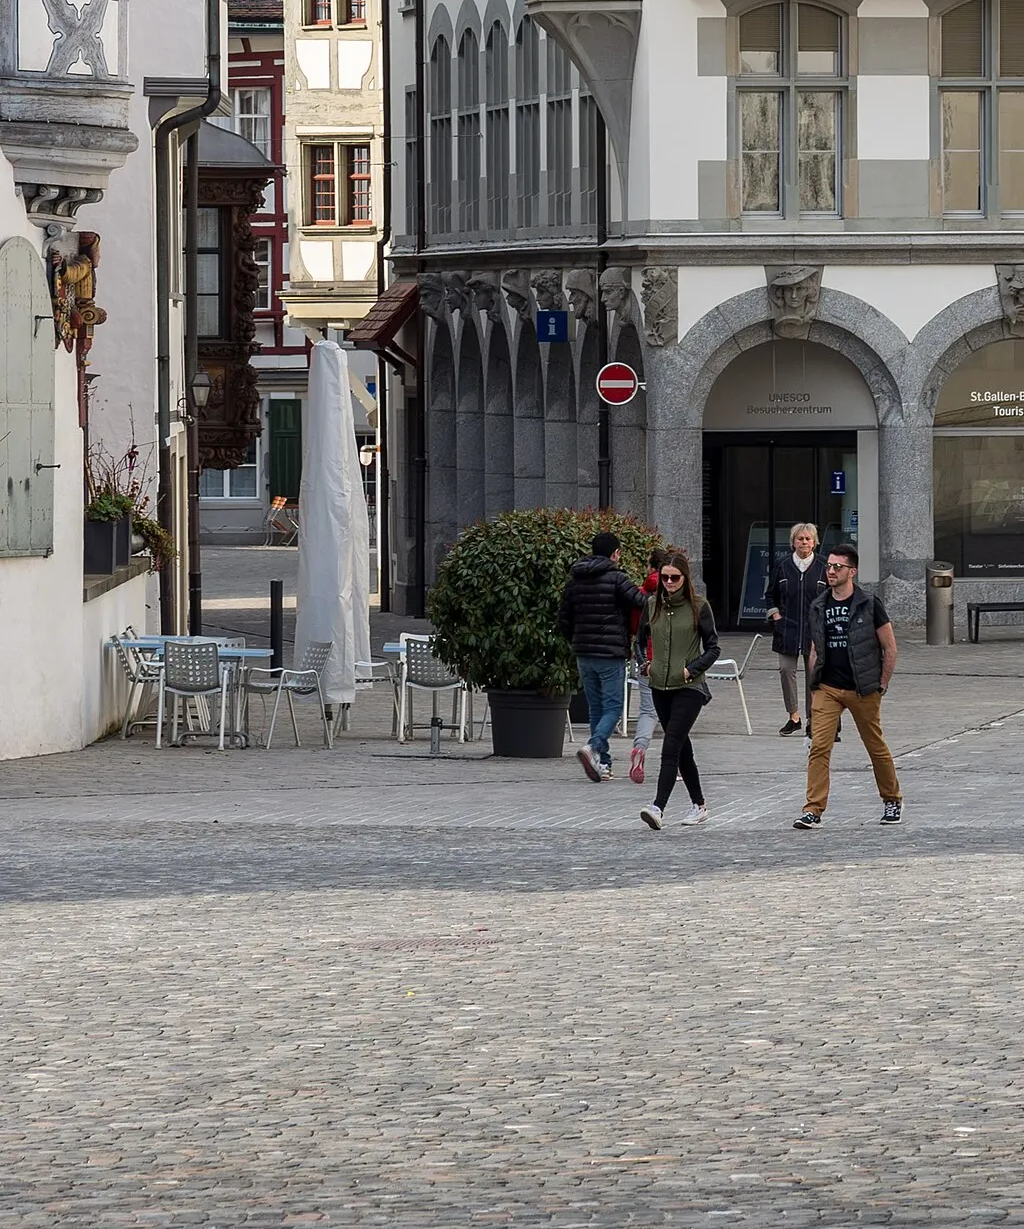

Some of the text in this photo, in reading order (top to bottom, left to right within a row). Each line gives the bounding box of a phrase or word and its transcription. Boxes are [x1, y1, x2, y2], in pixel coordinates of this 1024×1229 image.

[768, 393, 811, 402] UNESCO
[746, 404, 832, 414] Besucherzentrum
[825, 606, 850, 618] FITC
